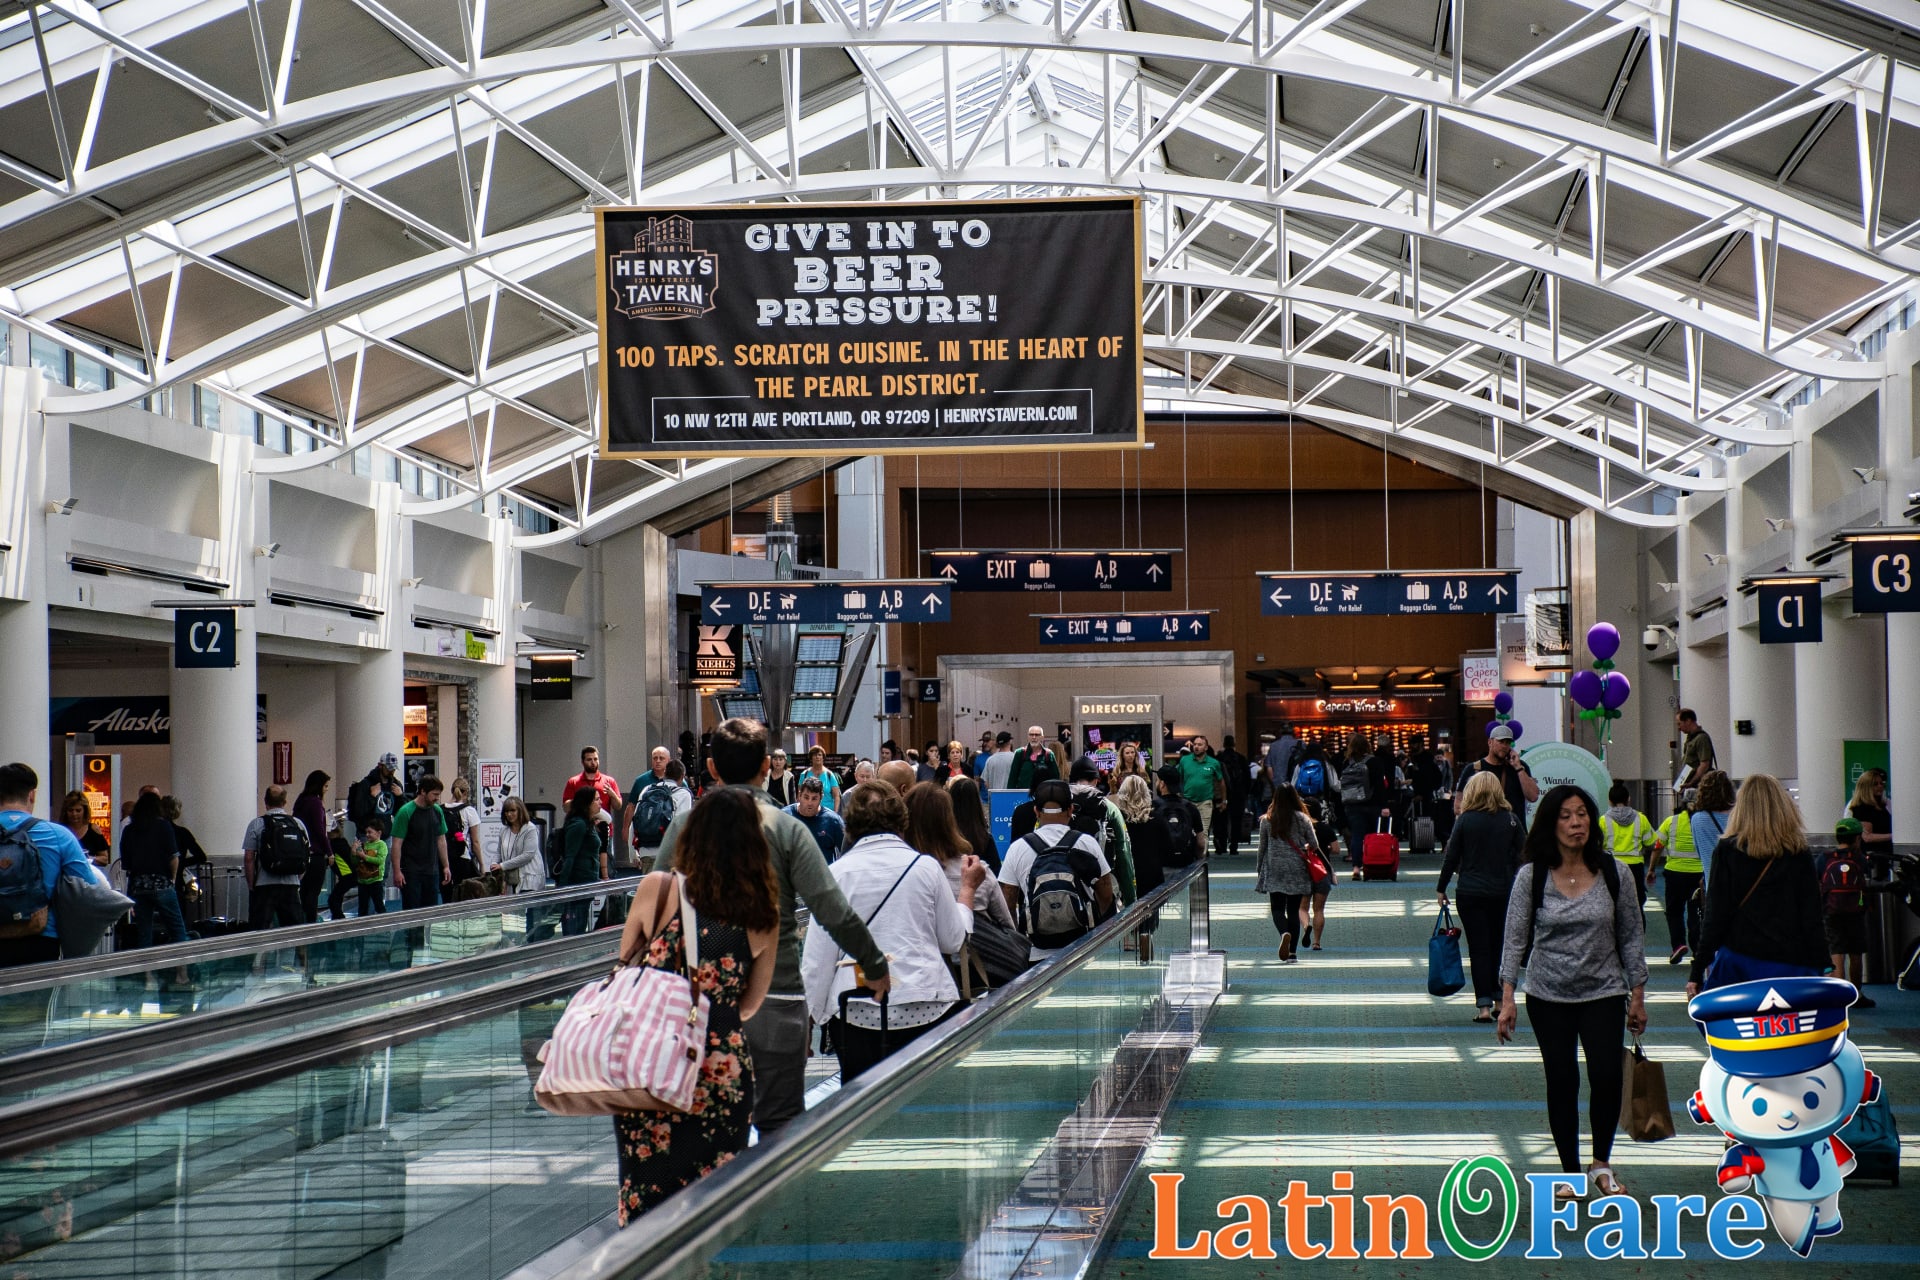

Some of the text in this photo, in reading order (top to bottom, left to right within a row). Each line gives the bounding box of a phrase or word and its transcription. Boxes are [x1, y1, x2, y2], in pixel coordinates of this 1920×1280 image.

[745, 219, 990, 251] GIVE IN TO
[616, 256, 713, 277] HENRY'S
[794, 254, 943, 293] BEER
[625, 284, 703, 304] TAVERN
[631, 306, 663, 316] AMERICAN
[683, 306, 700, 315] GRILL
[756, 294, 997, 326] PRESSURE!
[616, 336, 1123, 368] 100 TAPS. SCRATCH CUISINE. IN THE HEART OF
[755, 373, 986, 399] THE PEARL DISTRICT.
[664, 414, 679, 428] 10
[685, 413, 709, 428] NW
[714, 412, 747, 428] 12TH
[752, 412, 777, 427] AVE
[782, 411, 855, 428] PORTLAND,
[861, 410, 881, 425] OR
[886, 409, 930, 424] 97209
[944, 406, 1077, 424] HENRYSTAVERN.COM
[986, 560, 1118, 582] EXIT A,B
[1872, 554, 1912, 593] C3
[1024, 582, 1043, 590] Baggage
[1310, 581, 1468, 605] D,E A,B
[749, 590, 903, 613] D,E A,B
[1314, 604, 1328, 612] Gates
[1348, 604, 1362, 612] Relief
[1400, 604, 1421, 612] Baggage
[1777, 596, 1804, 628] C1
[753, 613, 767, 621] Gates
[837, 613, 858, 621] Baggage
[885, 612, 898, 620] Gates
[1068, 618, 1179, 635] EXIT A,B
[189, 621, 221, 653] C2
[697, 660, 736, 668] KIEHL'S
[1464, 666, 1498, 679] Capers
[1471, 677, 1492, 688] Café
[1081, 703, 1152, 714] DIRECTORY
[1316, 698, 1397, 713] Capers Wine Bar
[88, 707, 170, 734] Alaska
[1543, 776, 1576, 785] Wander
